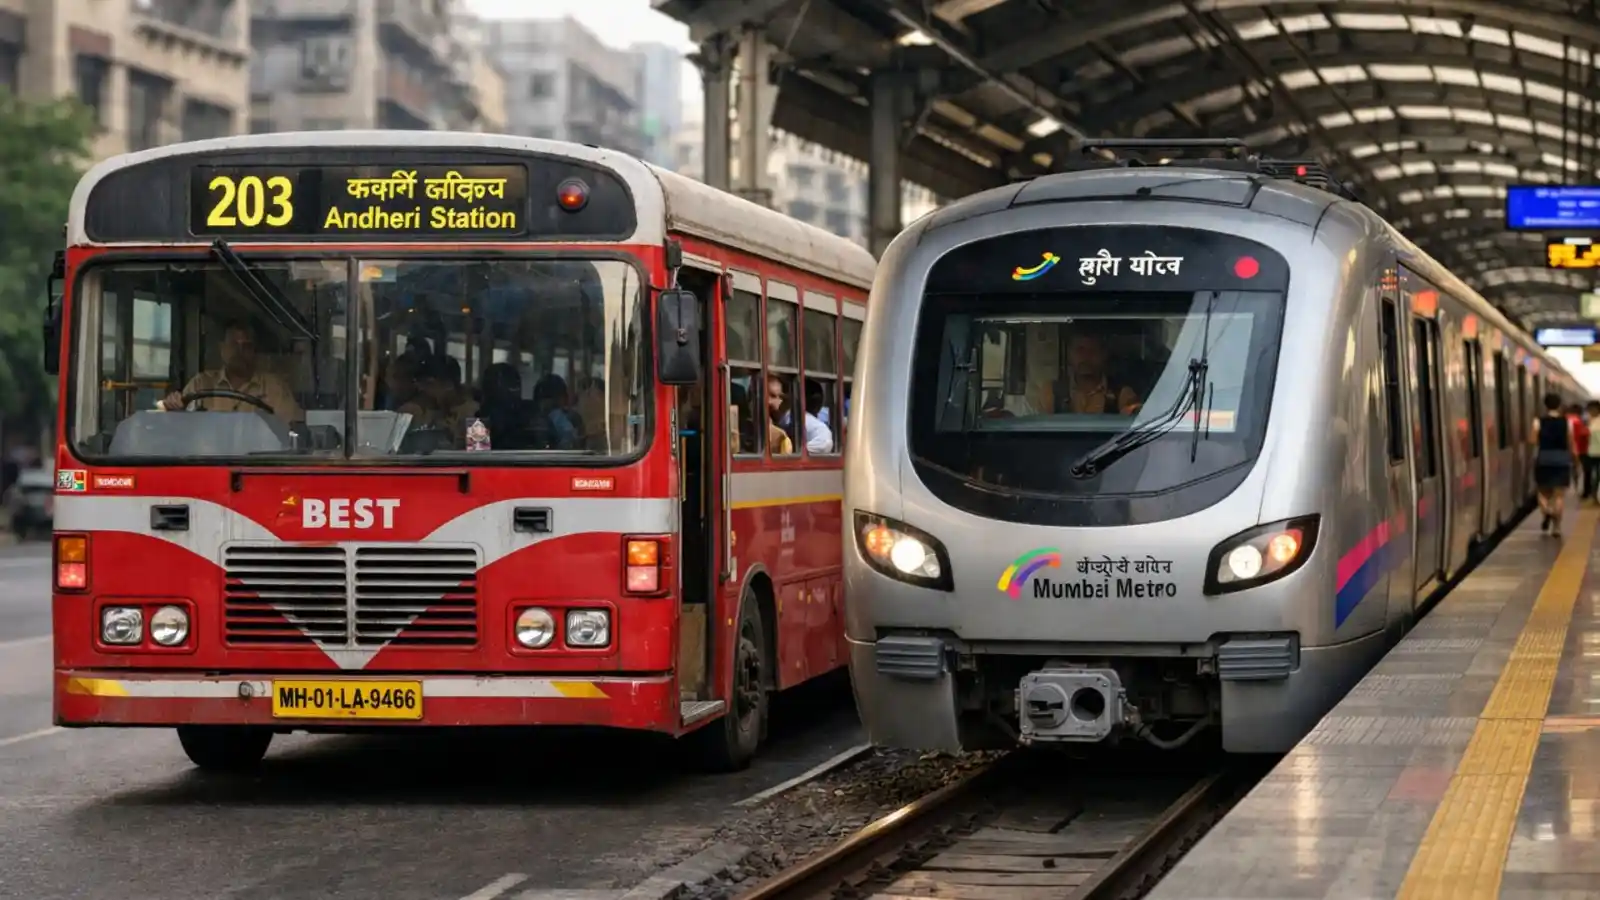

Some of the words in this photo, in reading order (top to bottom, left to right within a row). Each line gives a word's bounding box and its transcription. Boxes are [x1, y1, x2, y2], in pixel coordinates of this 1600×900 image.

[206, 175, 293, 227] 203
[324, 206, 421, 229] Andheri
[429, 206, 516, 229] Station
[302, 498, 401, 529] BEST
[1033, 577, 1109, 599] Mumbai
